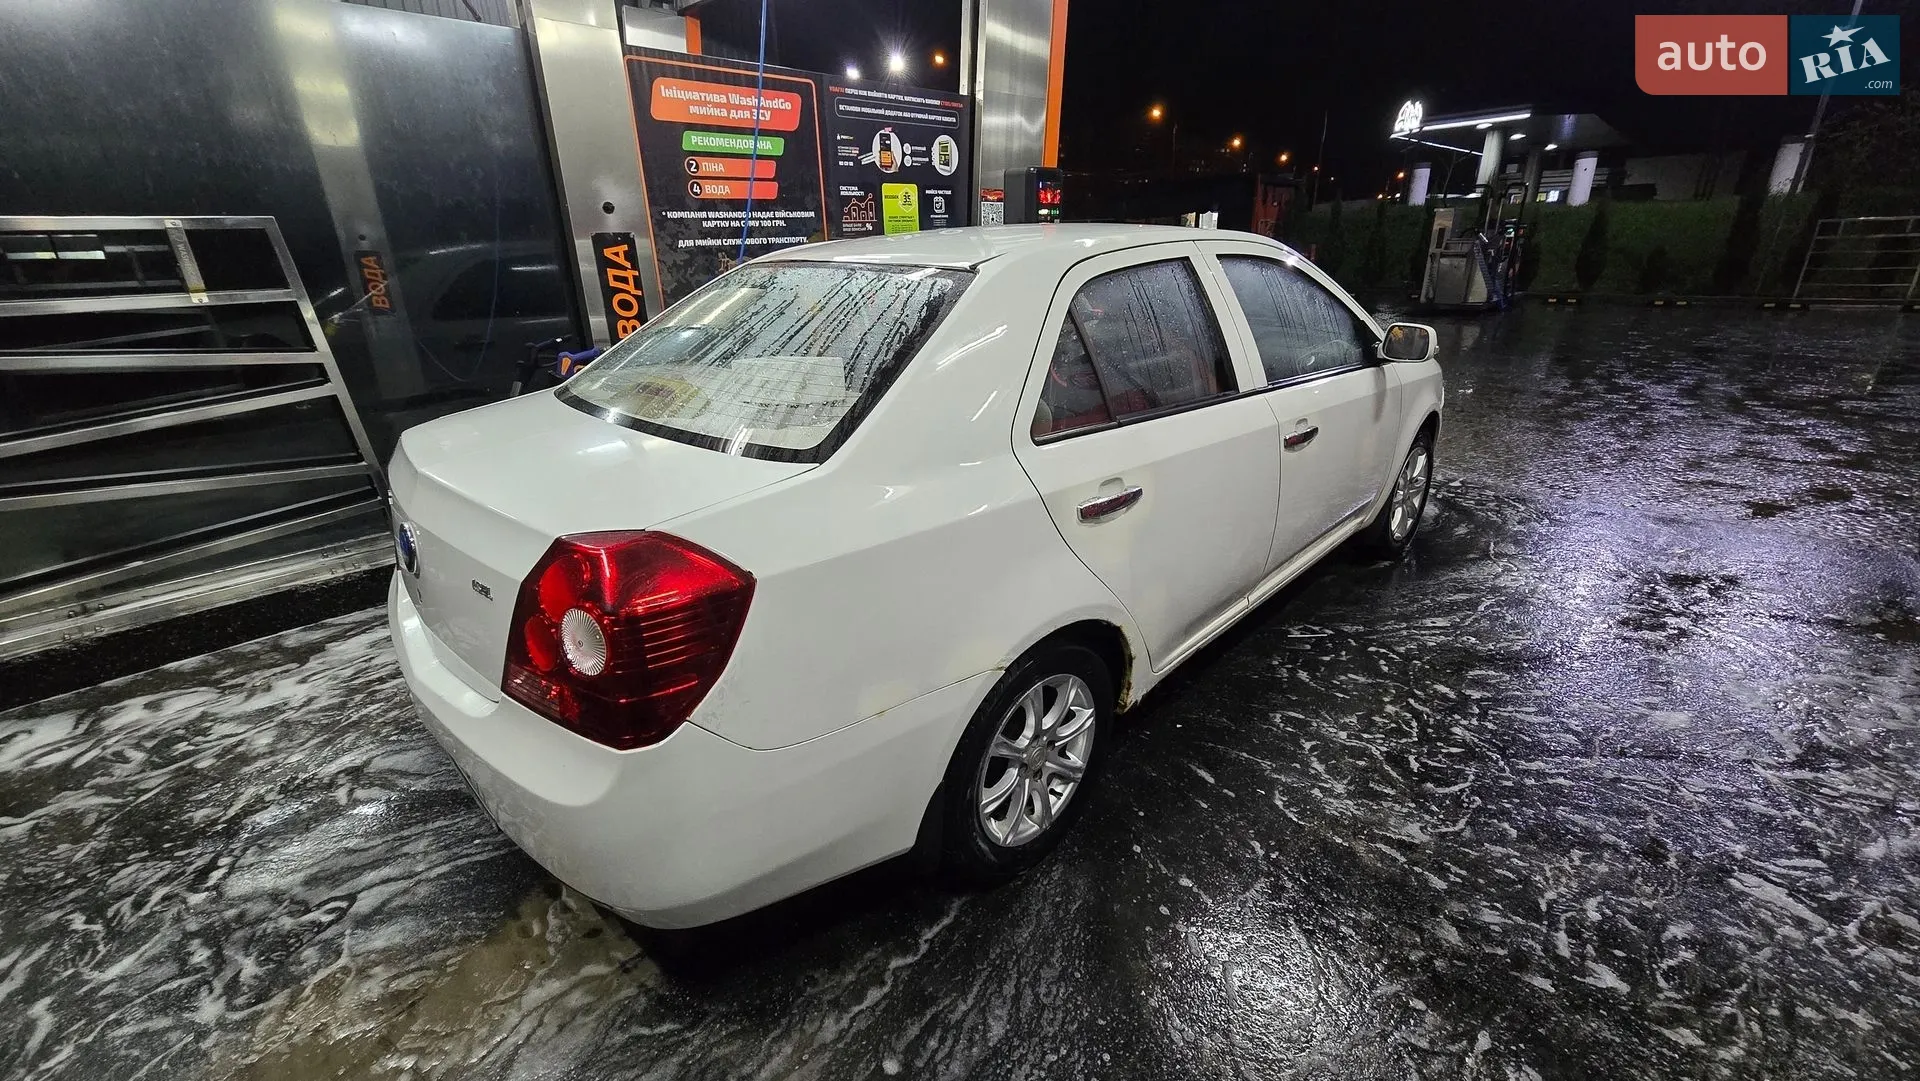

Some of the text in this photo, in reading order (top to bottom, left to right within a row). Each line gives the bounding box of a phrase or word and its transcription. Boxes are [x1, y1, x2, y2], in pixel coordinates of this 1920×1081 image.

[728, 92, 792, 110] WashAndGo
[689, 103, 771, 121] мийка для ЗСУ
[691, 135, 773, 150] РЕКОМЕНДОВАНА
[689, 160, 725, 173] 2 ПІНА
[692, 183, 731, 195] 4 ВОДА
[667, 211, 707, 219] КОМПАНІЯ
[702, 220, 730, 228] КАРТКУ
[678, 236, 809, 248] ДЛЯ МИЙКИ СЛУЖОВОГО ТРАНСПОРТУ.
[360, 256, 391, 309] ВОДА
[603, 244, 643, 339] ВОДА
